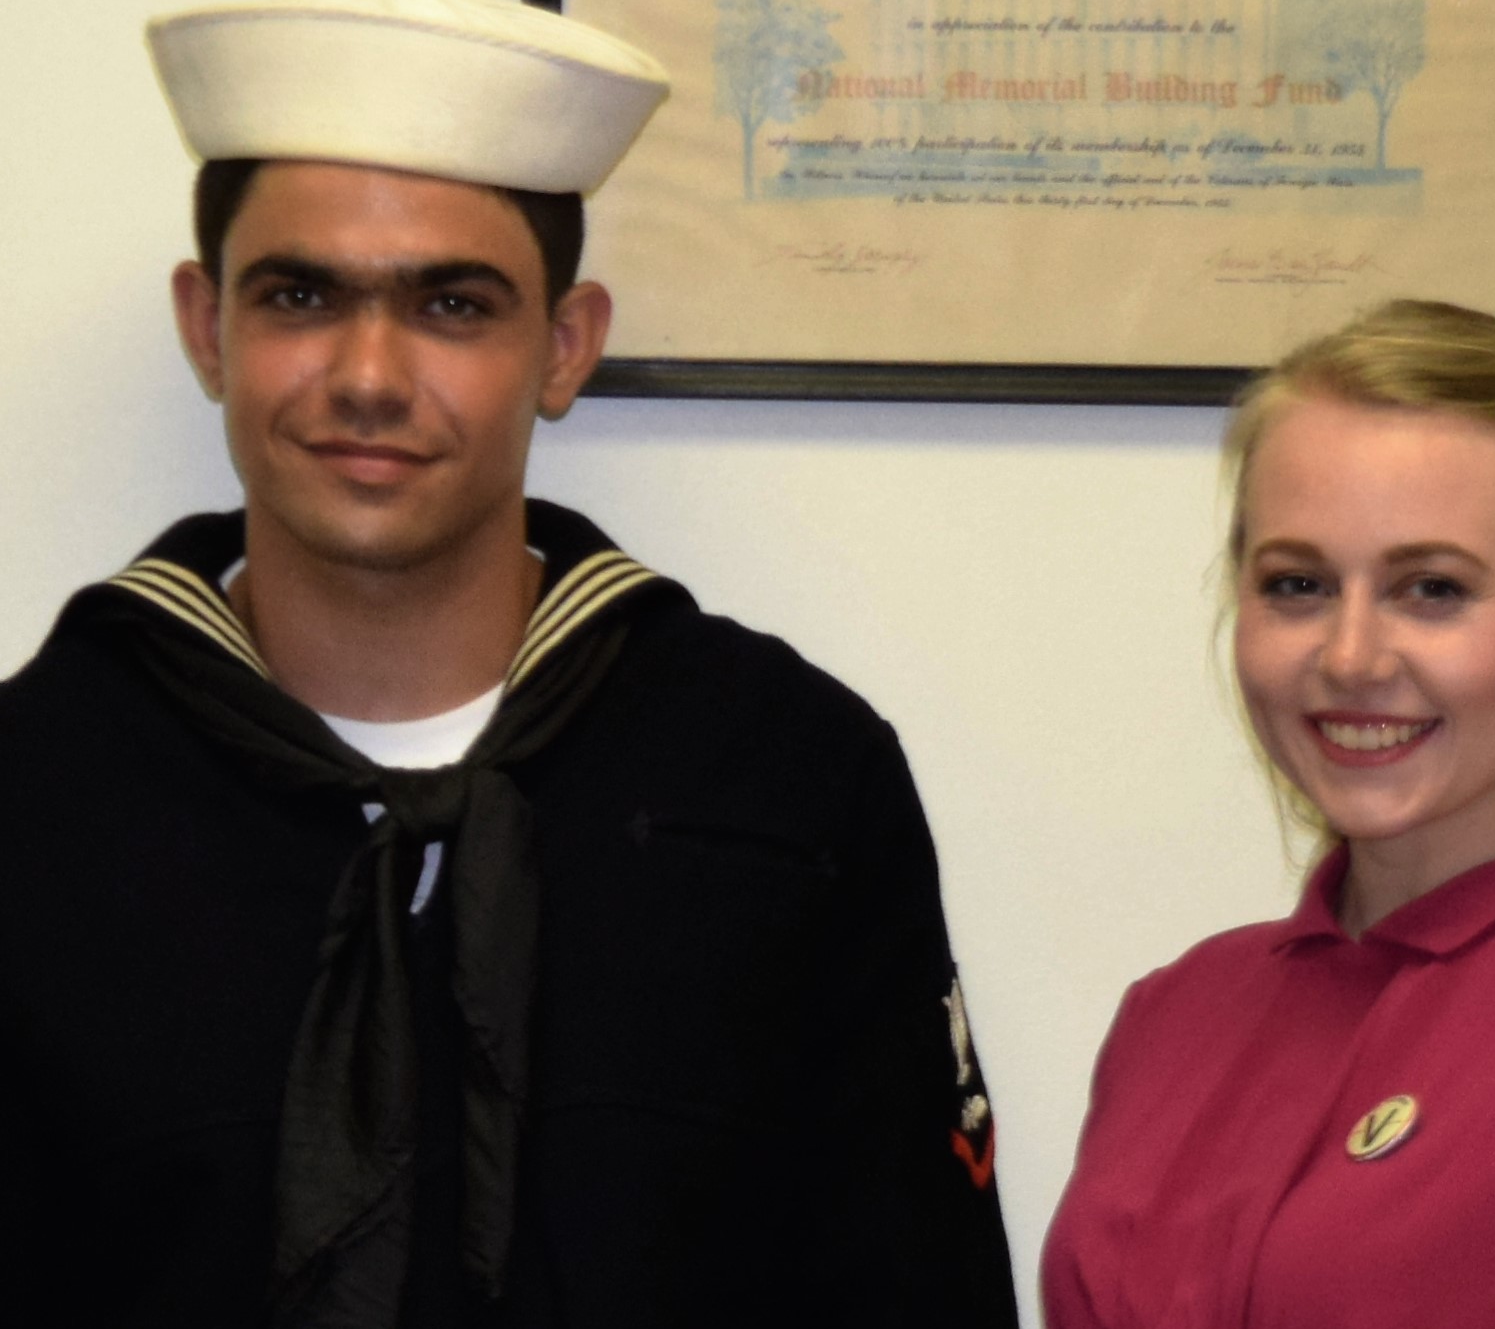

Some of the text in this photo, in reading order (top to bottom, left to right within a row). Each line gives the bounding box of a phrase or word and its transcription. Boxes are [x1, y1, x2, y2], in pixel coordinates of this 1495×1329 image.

[797, 69, 1344, 109] National Memorial Building Fund
[1362, 1108, 1399, 1148] V
